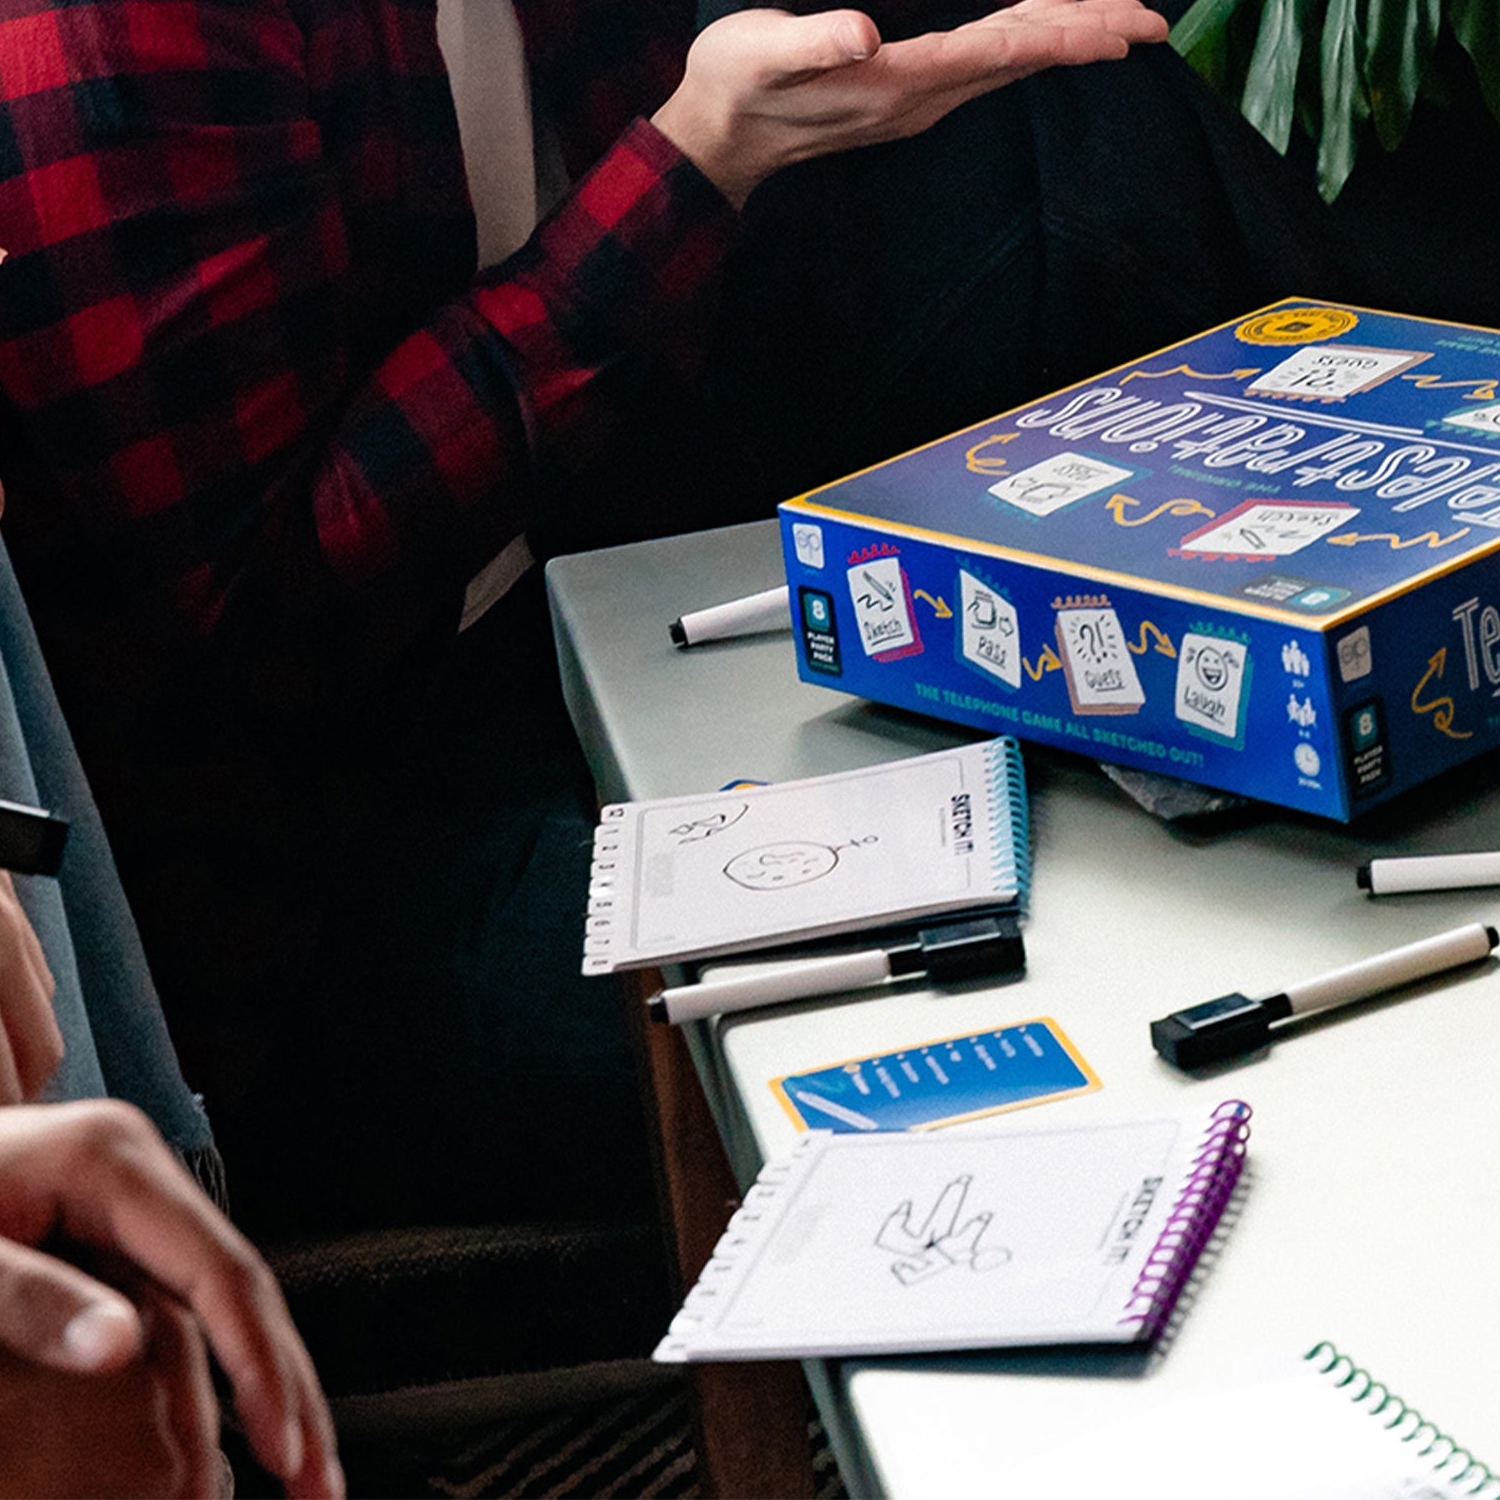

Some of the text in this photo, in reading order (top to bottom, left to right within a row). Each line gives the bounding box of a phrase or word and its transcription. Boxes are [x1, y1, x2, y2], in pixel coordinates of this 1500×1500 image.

[811, 599, 826, 621] 8
[807, 631, 835, 644] PLAYER
[864, 617, 904, 642] Sketch
[810, 642, 835, 654] PARTY
[813, 651, 834, 663] PACK
[1084, 668, 1125, 689] Guess
[1183, 685, 1226, 718] Laugh
[915, 682, 1204, 768] THE TELEPHONE GAME ALL SKETCHED OUT!
[1358, 712, 1374, 737] 8
[951, 793, 972, 840] SKETCH
